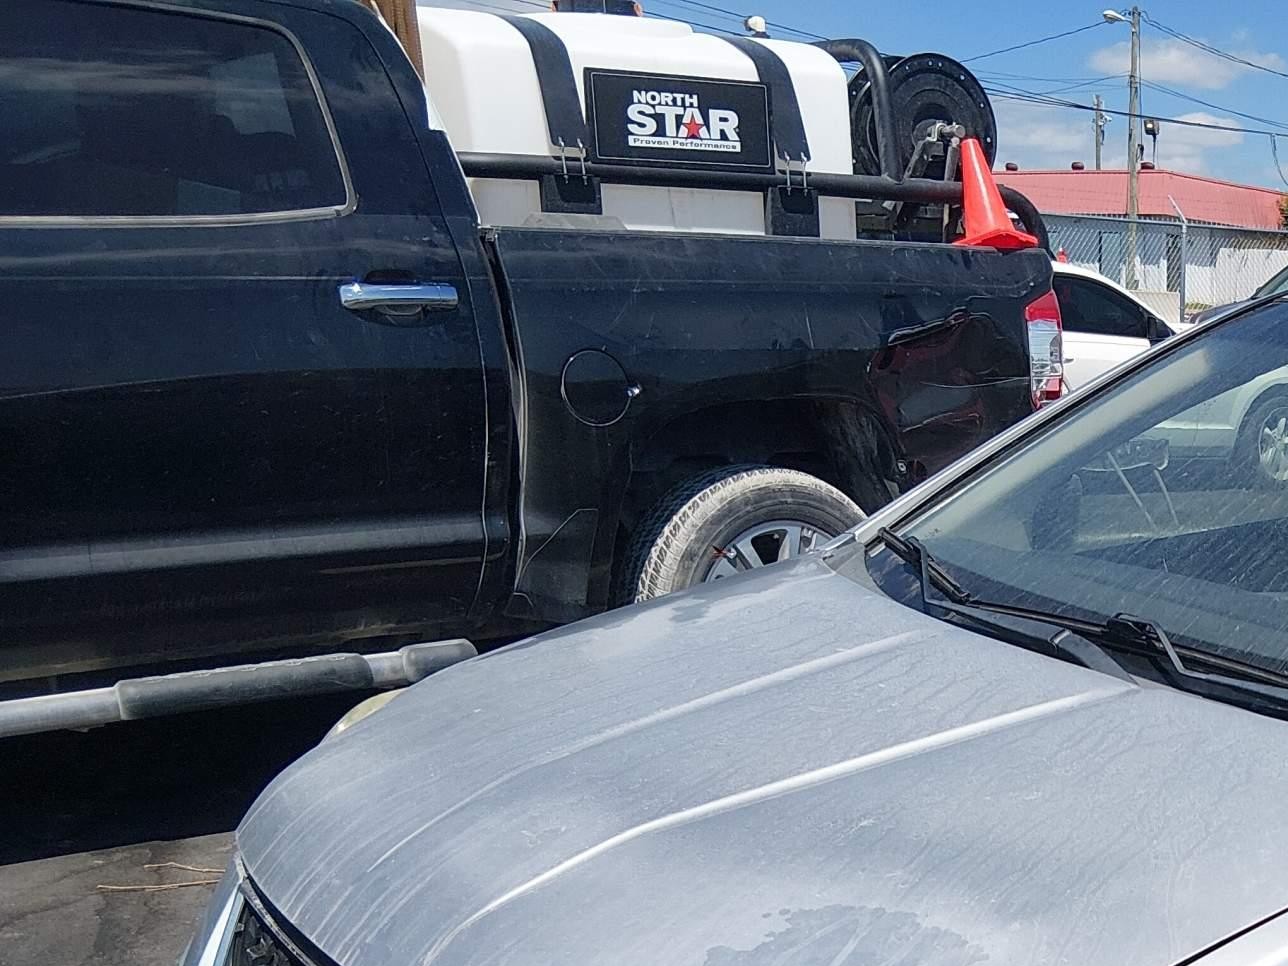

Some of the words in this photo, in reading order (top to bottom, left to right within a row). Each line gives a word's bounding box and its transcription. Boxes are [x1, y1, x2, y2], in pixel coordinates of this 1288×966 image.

[633, 90, 698, 107] NORTH
[626, 104, 740, 141] STAR
[633, 137, 669, 146] Proven
[672, 139, 737, 150] Performance
